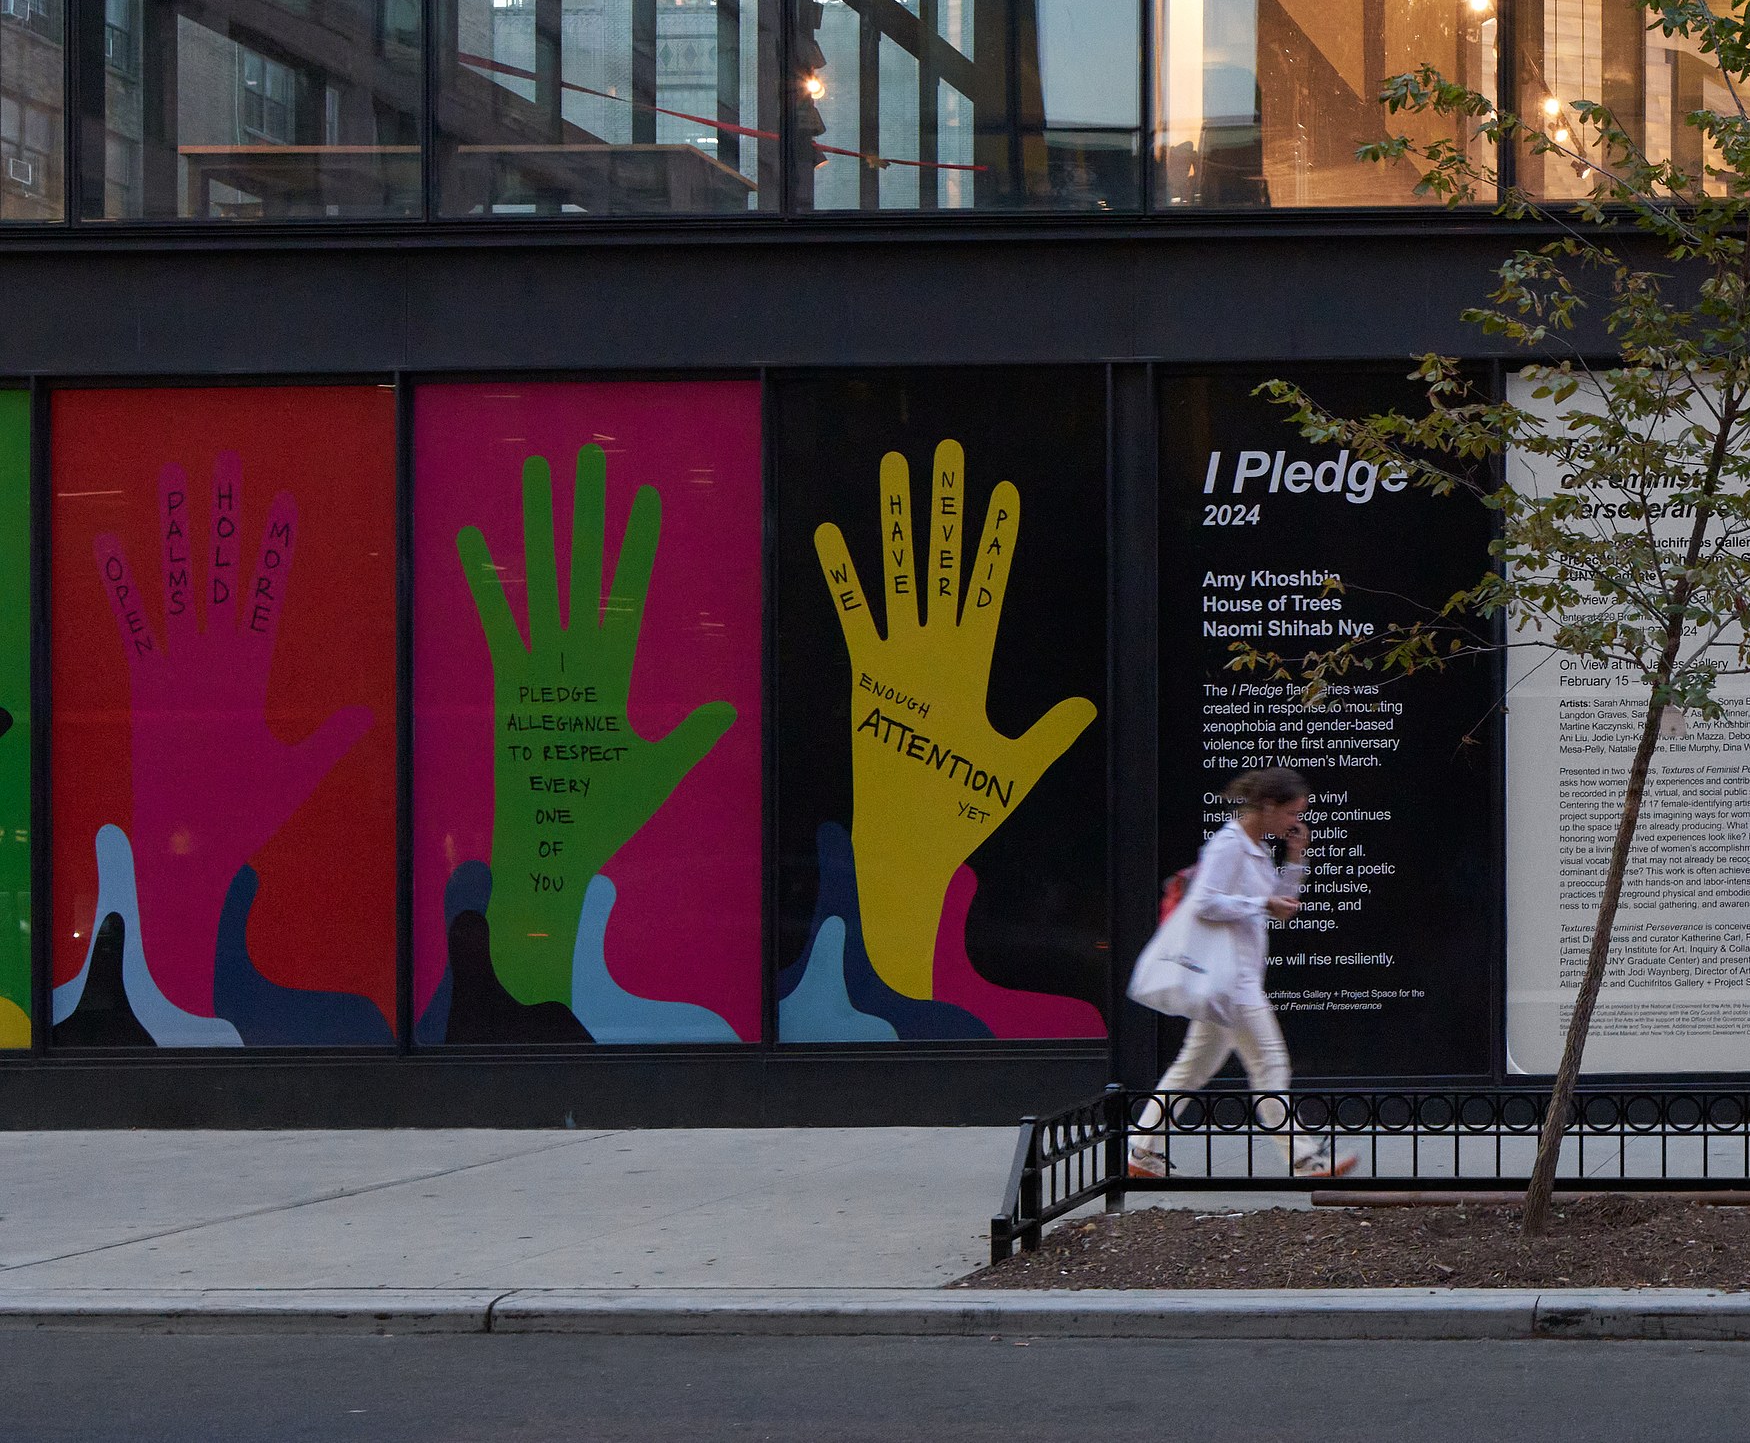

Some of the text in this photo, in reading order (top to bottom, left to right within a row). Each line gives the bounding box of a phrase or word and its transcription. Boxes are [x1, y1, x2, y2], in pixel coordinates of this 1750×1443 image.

[1202, 450, 1408, 504] I Pledge
[1202, 505, 1260, 526] 2024
[939, 471, 957, 597] NEVER
[212, 484, 235, 604] HOLD
[889, 495, 910, 594] HAVE
[166, 490, 187, 615] PALMS
[977, 509, 1008, 608] PAID
[250, 523, 292, 633] MORE
[1202, 571, 1245, 591] Amy
[830, 563, 863, 611] WE
[105, 556, 153, 656] OPEN
[1203, 596, 1342, 612] House of Trees
[1203, 620, 1374, 639] Naomi Shihab Nye
[1560, 660, 1576, 670] On
[1581, 660, 1608, 670] View
[1611, 660, 1622, 669] at
[1559, 676, 1628, 688] February 15
[519, 686, 598, 703] PLEDGE
[859, 673, 931, 718] ENOUGH
[1204, 685, 1227, 696] The
[1232, 685, 1236, 696] I
[1239, 684, 1283, 698] Pledge
[1322, 684, 1350, 694] eries
[1354, 685, 1378, 694] was
[1204, 703, 1250, 714] created
[1254, 703, 1264, 713] in
[1560, 699, 1591, 707] Artists:
[1593, 699, 1617, 707] Sarah
[1718, 697, 1743, 707] Sonya
[507, 715, 620, 733] ALLEGIANCE
[1560, 711, 1595, 722] Langdon
[1203, 719, 1393, 734] xenophobia and gender-based
[1560, 722, 1590, 731] Martine
[1693, 721, 1711, 730] Amy
[1204, 737, 1400, 751] violence for the first anniversary
[1560, 734, 1573, 742] Ani
[507, 745, 629, 763] TO RESPECT
[1608, 744, 1636, 752] Natalie
[1723, 743, 1741, 751] Dina
[858, 708, 1014, 808] ATTENTION
[1204, 755, 1381, 768] of the 2017 Women's March.
[1560, 767, 1600, 775] Presented
[1662, 766, 1694, 774] Textures
[530, 776, 591, 795] EVERY
[1204, 793, 1222, 804] On
[1309, 794, 1315, 802] a
[1320, 791, 1347, 805] vinyl
[536, 809, 574, 824] ONE
[958, 801, 990, 824] YET
[1331, 809, 1391, 820] continues
[1311, 828, 1347, 841] public
[538, 841, 564, 858] OF
[1329, 845, 1345, 856] for
[1349, 845, 1365, 856] all.
[1315, 863, 1342, 875] offer
[1346, 865, 1354, 874] a
[1357, 863, 1395, 876] poetic
[530, 872, 564, 892] YOU
[1298, 881, 1371, 894] or inclusive,
[1338, 899, 1361, 910] and
[1289, 918, 1339, 931] change.
[1265, 953, 1395, 967] we will rise resiliently.
[1303, 990, 1331, 1000] Gallery
[1341, 990, 1369, 1000] Project
[1371, 990, 1397, 999] Space
[1399, 989, 1409, 997] for
[1412, 989, 1424, 997] the
[1290, 1002, 1324, 1010] Feminist
[1326, 1002, 1382, 1010] Perseverance
